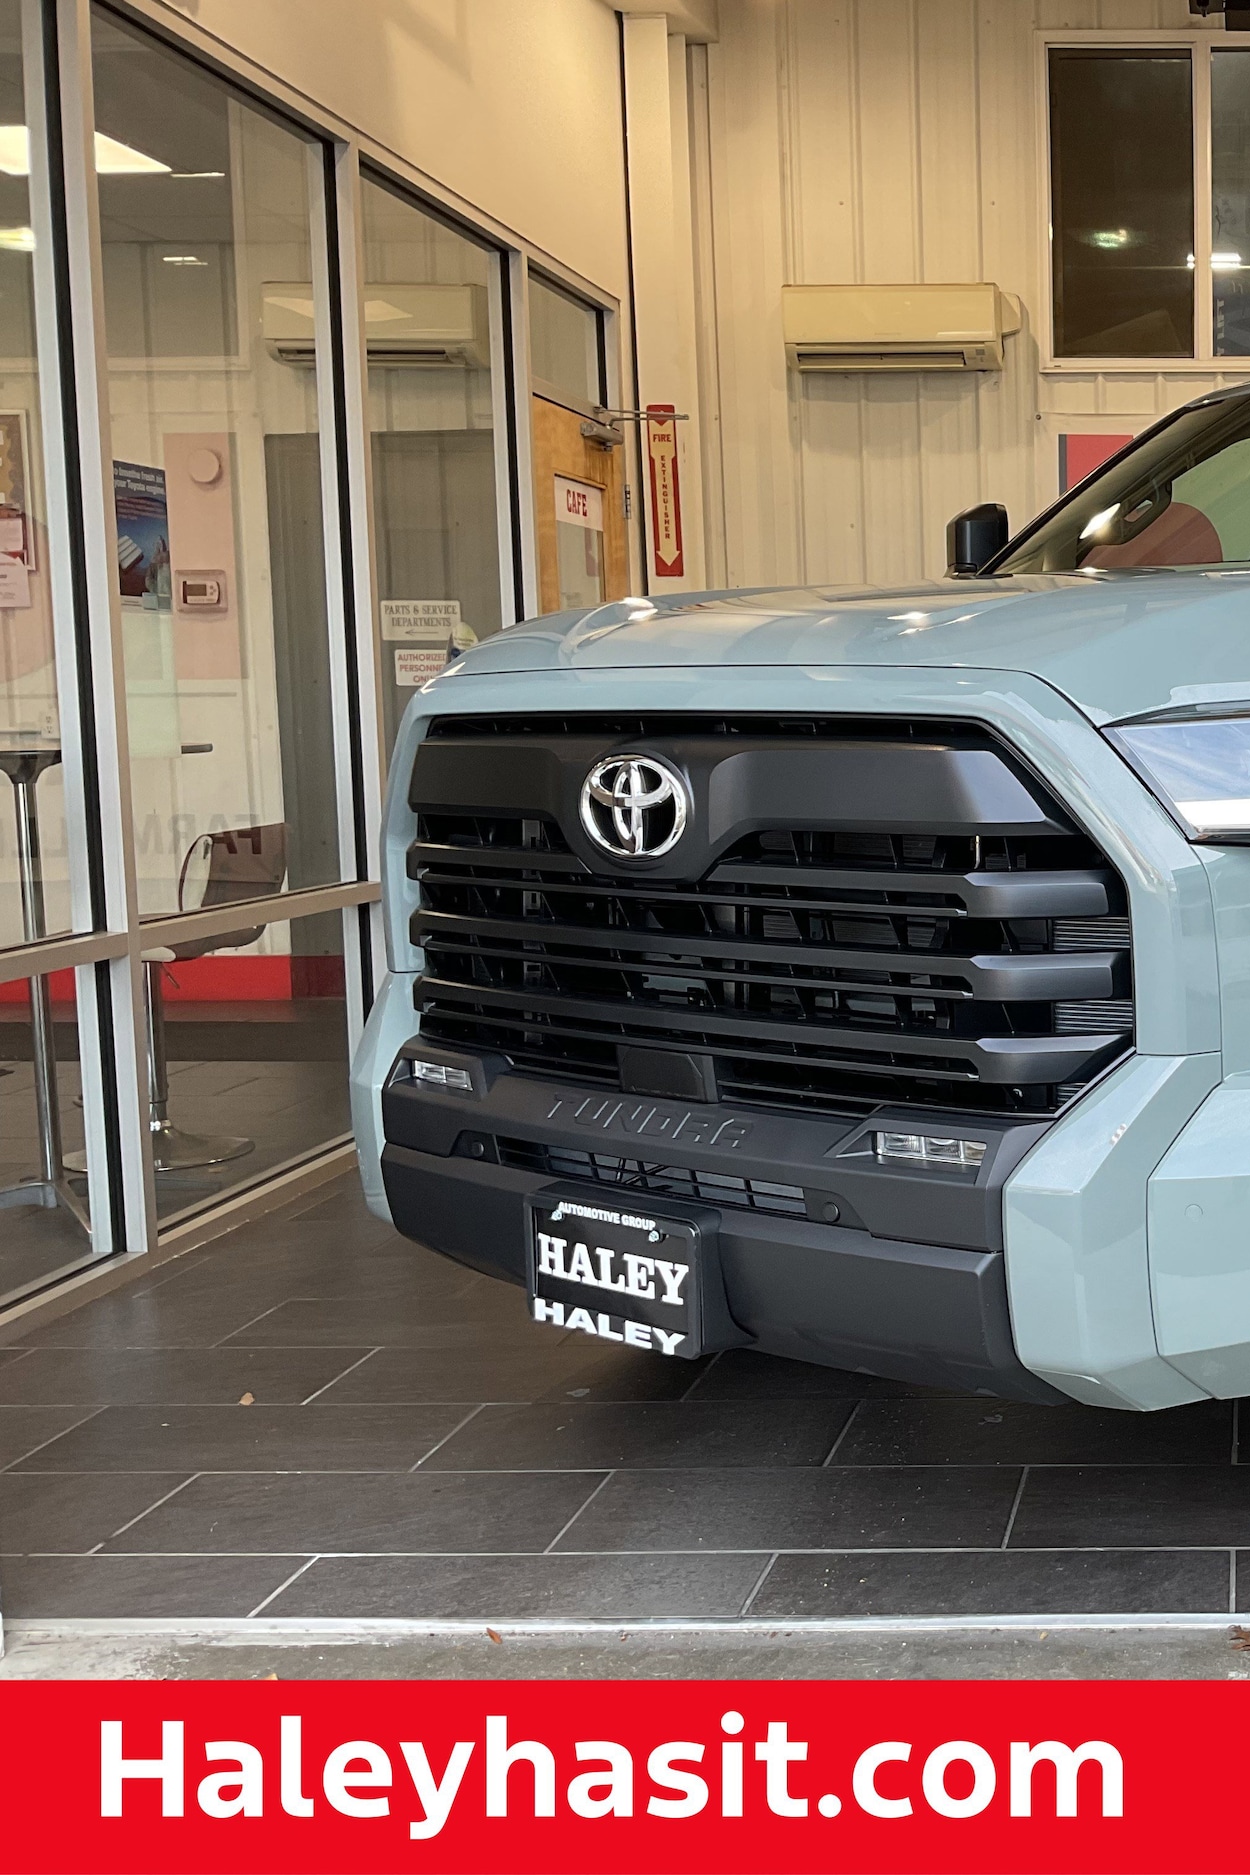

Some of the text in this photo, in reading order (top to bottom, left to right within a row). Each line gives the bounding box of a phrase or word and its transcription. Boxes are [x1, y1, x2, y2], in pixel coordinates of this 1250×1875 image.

[652, 433, 672, 443] FIRE
[566, 488, 588, 517] CAFE
[660, 455, 671, 540] EXTINGUISHER
[384, 605, 458, 615] PARTS & SERVICE
[391, 617, 451, 627] DEPARTMENTS
[400, 664, 444, 672] PERSONNE
[546, 1093, 753, 1148] TUNDRA
[558, 1201, 656, 1230] AUTOMOTIVE GROUP
[538, 1232, 689, 1305] HALEY
[534, 1297, 686, 1355] HALEY
